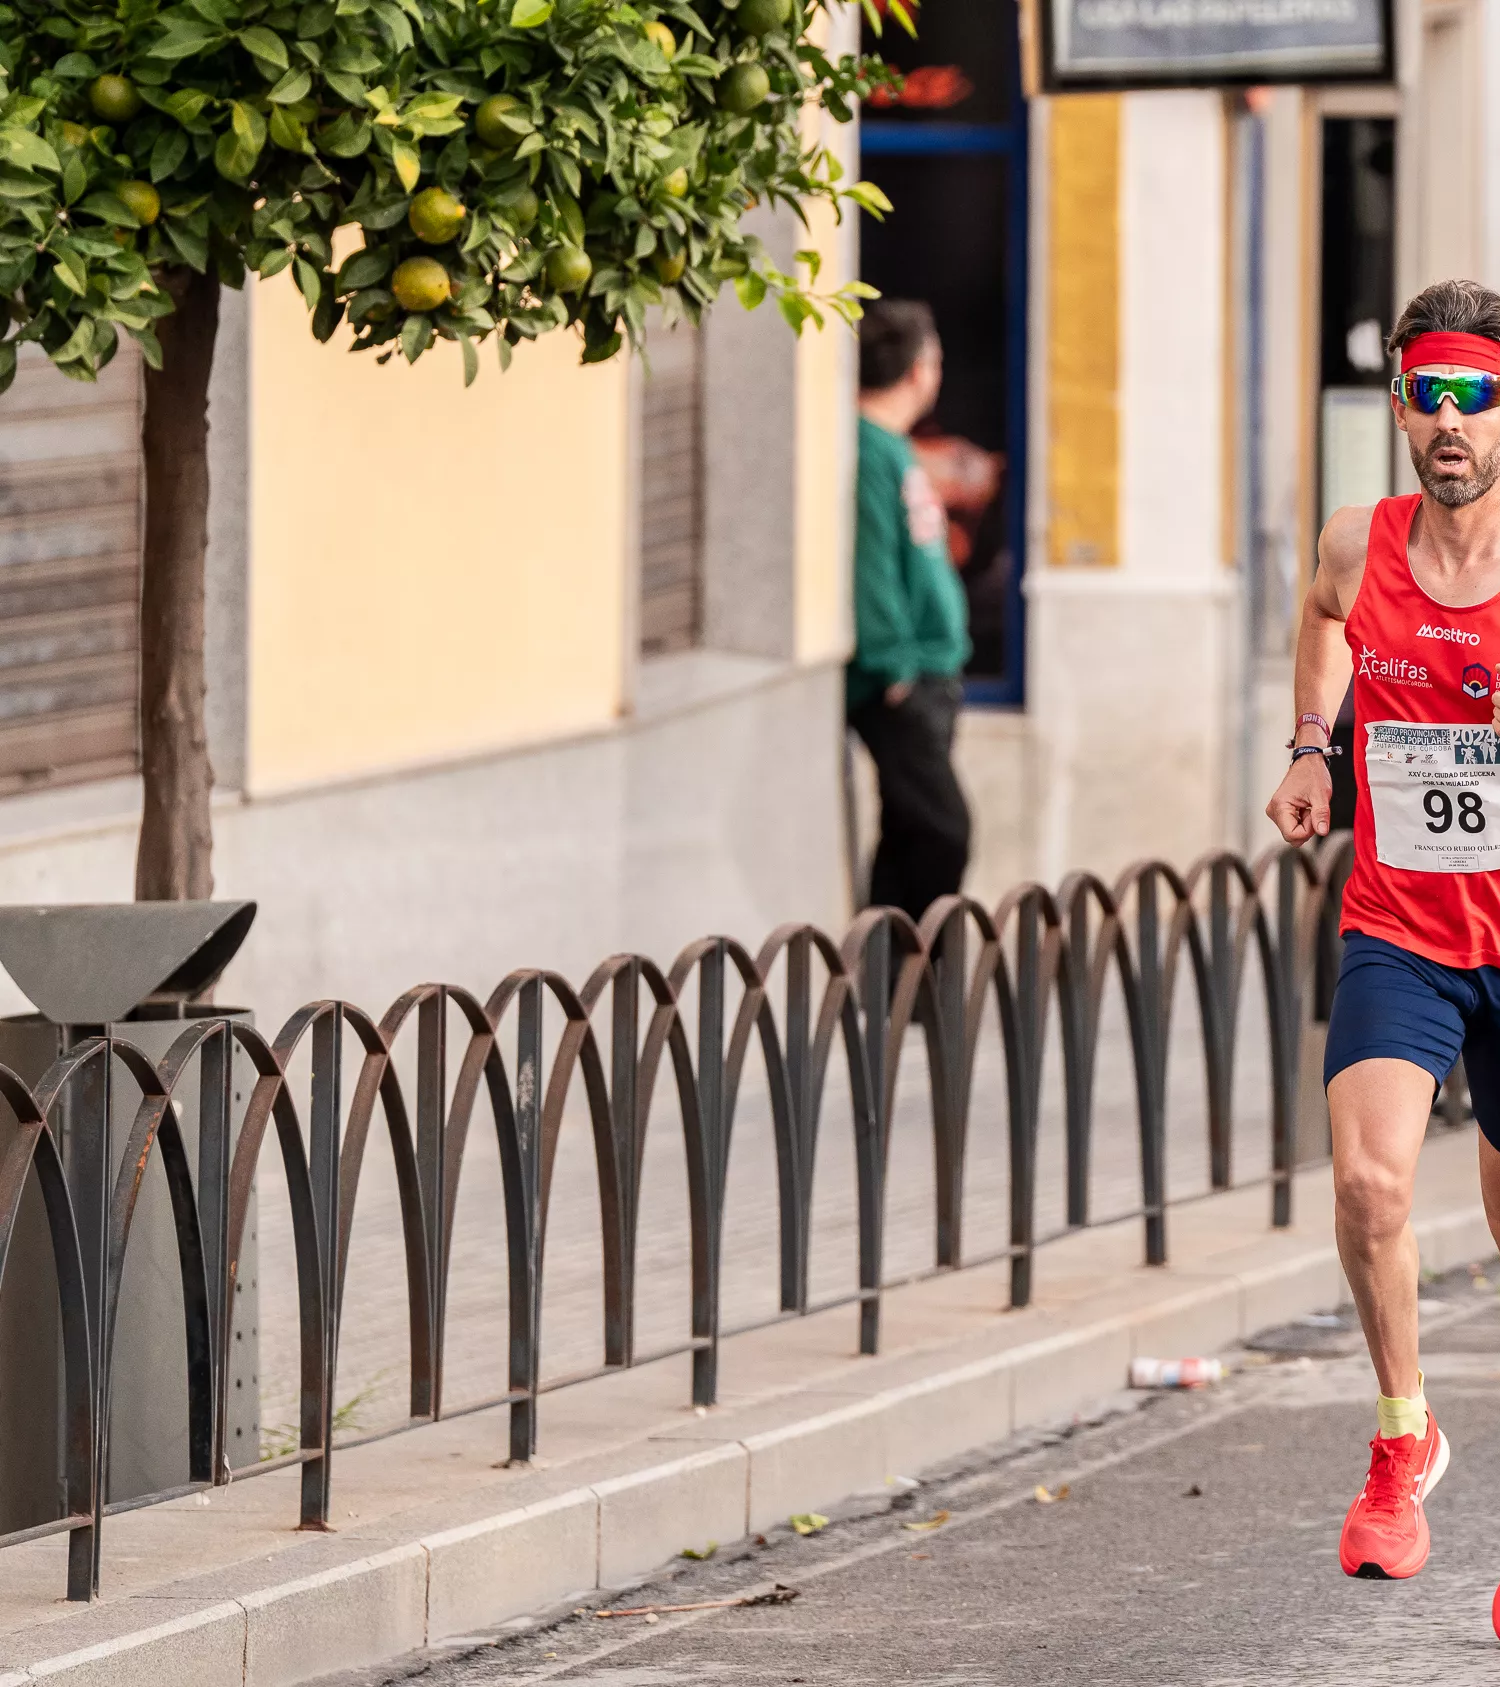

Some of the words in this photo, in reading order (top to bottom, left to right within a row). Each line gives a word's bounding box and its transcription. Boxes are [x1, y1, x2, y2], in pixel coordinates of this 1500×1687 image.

[1415, 623, 1481, 646] Mosttro
[1371, 657, 1428, 681] califas
[1373, 733, 1406, 744] CARRERAS
[1407, 736, 1451, 745] POPULARES
[1399, 728, 1440, 738] PROVINCIAL
[1441, 729, 1450, 737] DE
[1452, 728, 1497, 746] 2024
[1423, 789, 1486, 834] 98
[1414, 844, 1453, 852] FRANCISCO
